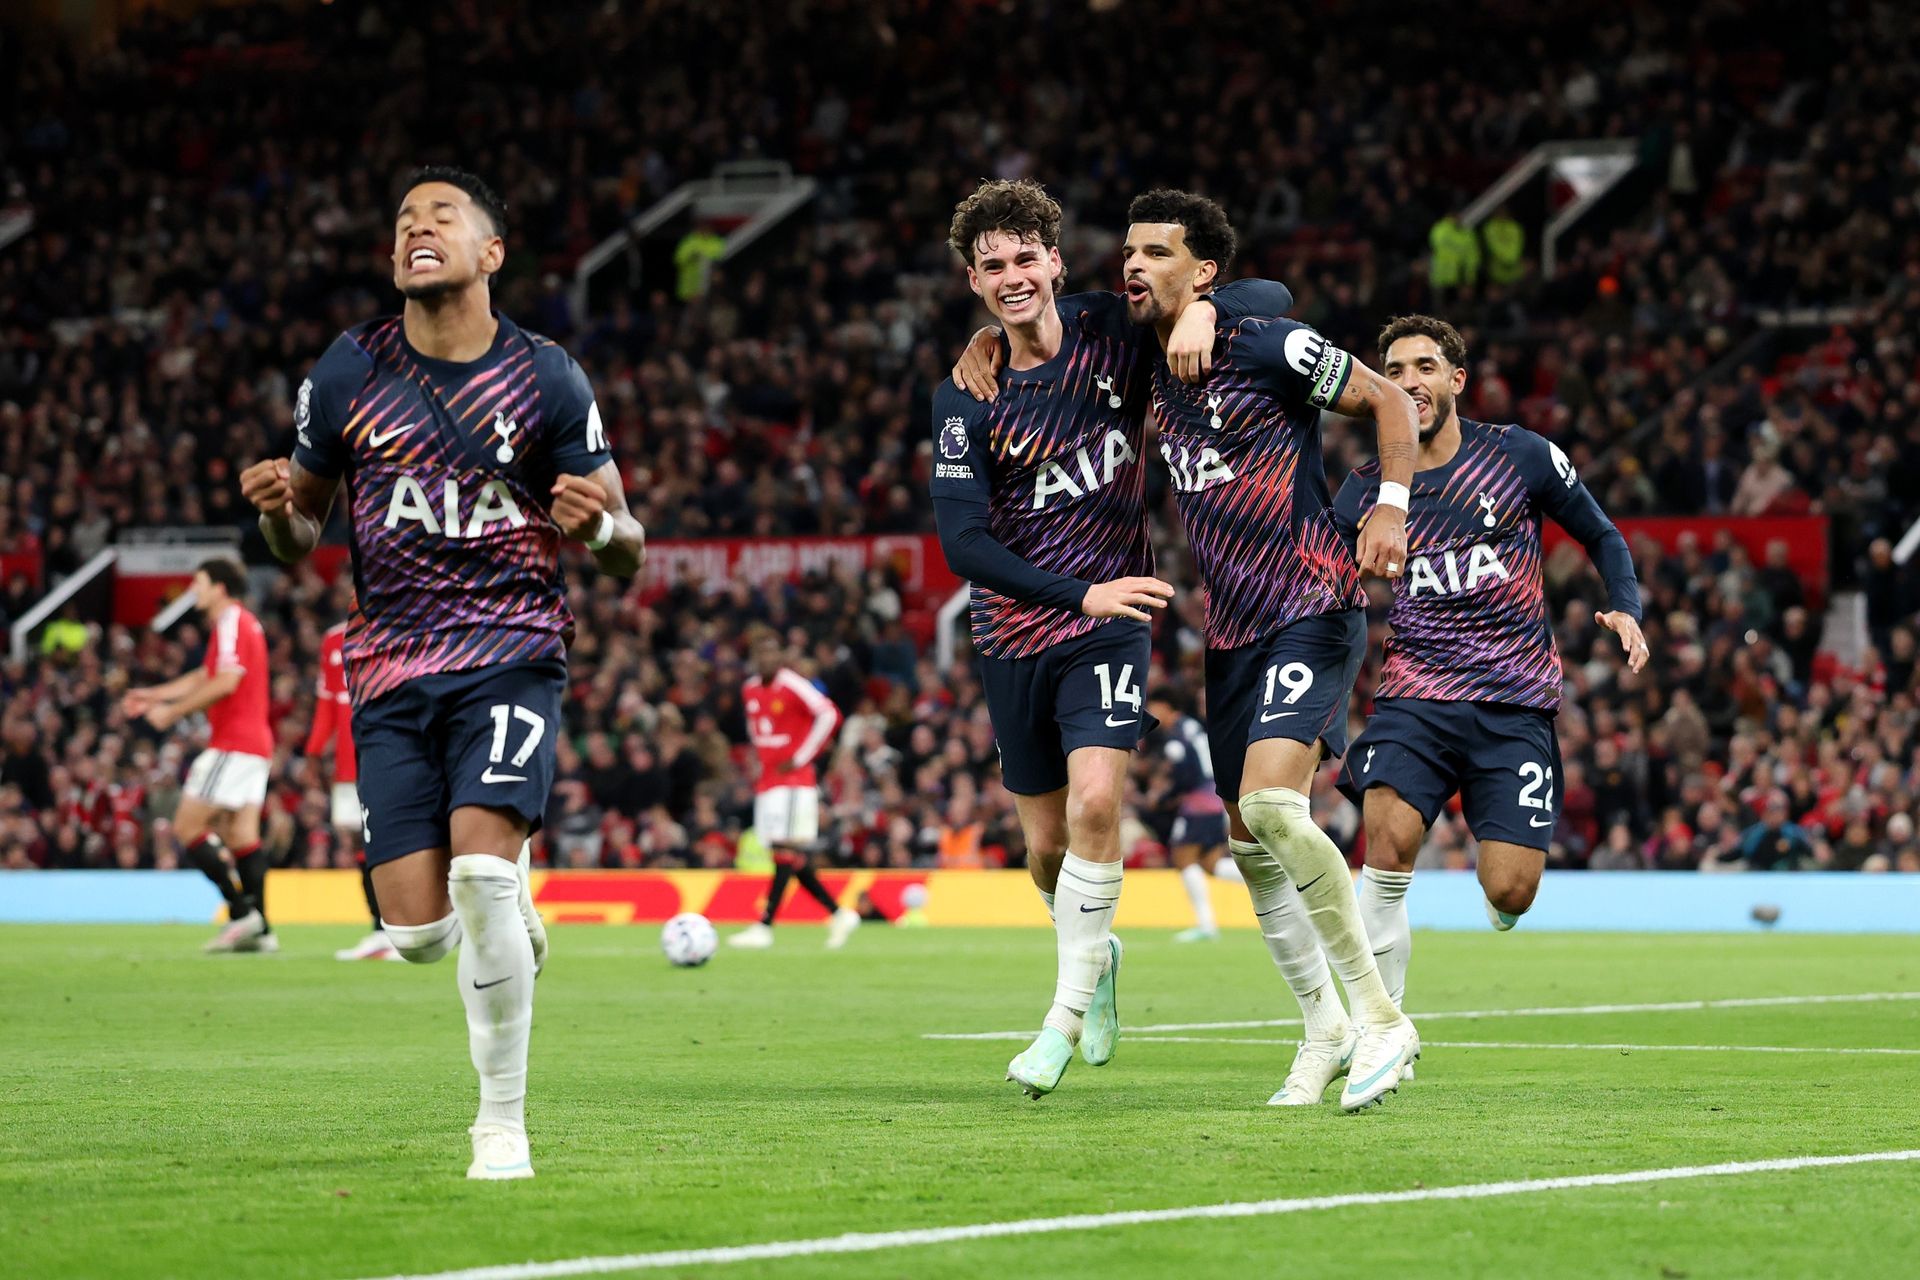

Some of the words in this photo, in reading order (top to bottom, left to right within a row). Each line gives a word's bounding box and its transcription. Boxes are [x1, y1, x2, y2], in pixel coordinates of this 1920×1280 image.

[936, 463, 946, 472] No
[1033, 429, 1137, 510] AIA
[383, 475, 528, 539] AIA
[1409, 543, 1510, 597] AIA
[1094, 663, 1142, 714] 14
[1263, 661, 1314, 706] 19
[489, 704, 546, 769] 17
